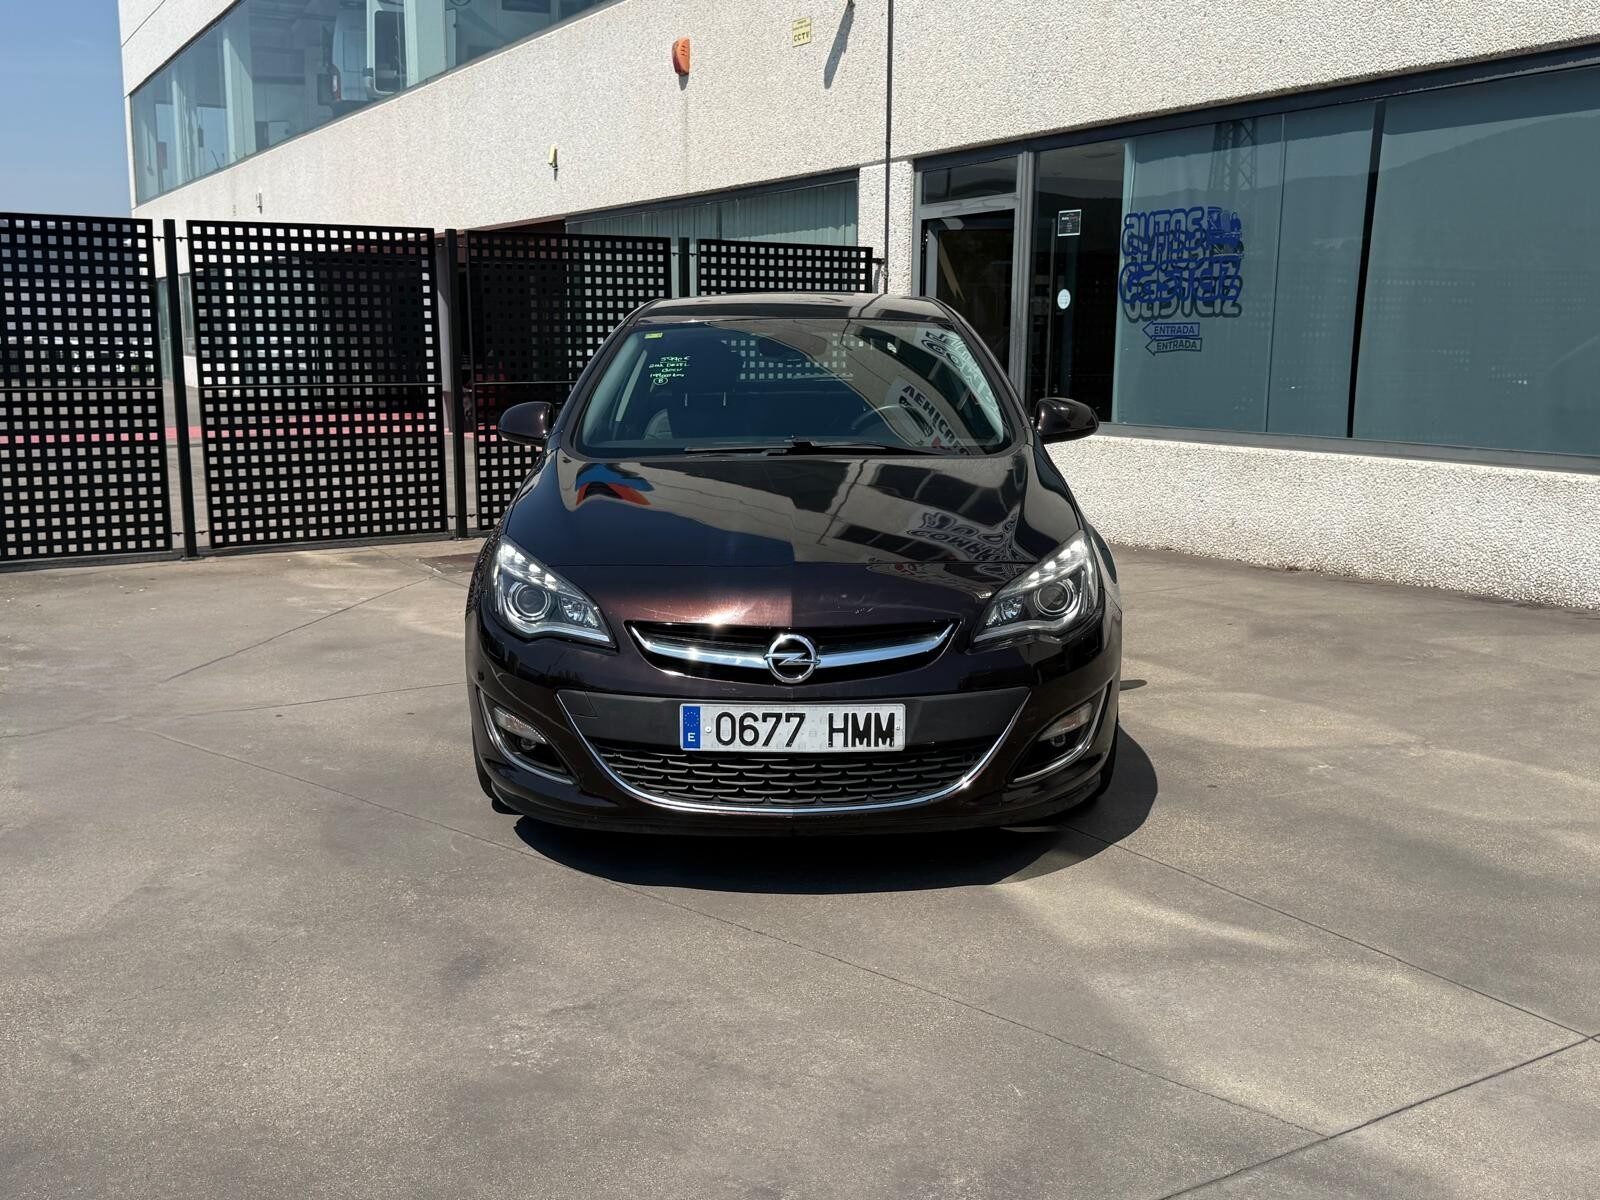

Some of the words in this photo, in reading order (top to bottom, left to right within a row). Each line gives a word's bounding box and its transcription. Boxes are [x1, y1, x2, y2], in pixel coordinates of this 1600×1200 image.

[793, 31, 810, 42] CCTV
[1154, 325, 1195, 335] ENTRADA
[1156, 340, 1198, 351] ENTRADA
[715, 711, 806, 747] 0677
[828, 712, 896, 748] HMM
[687, 732, 696, 742] E
